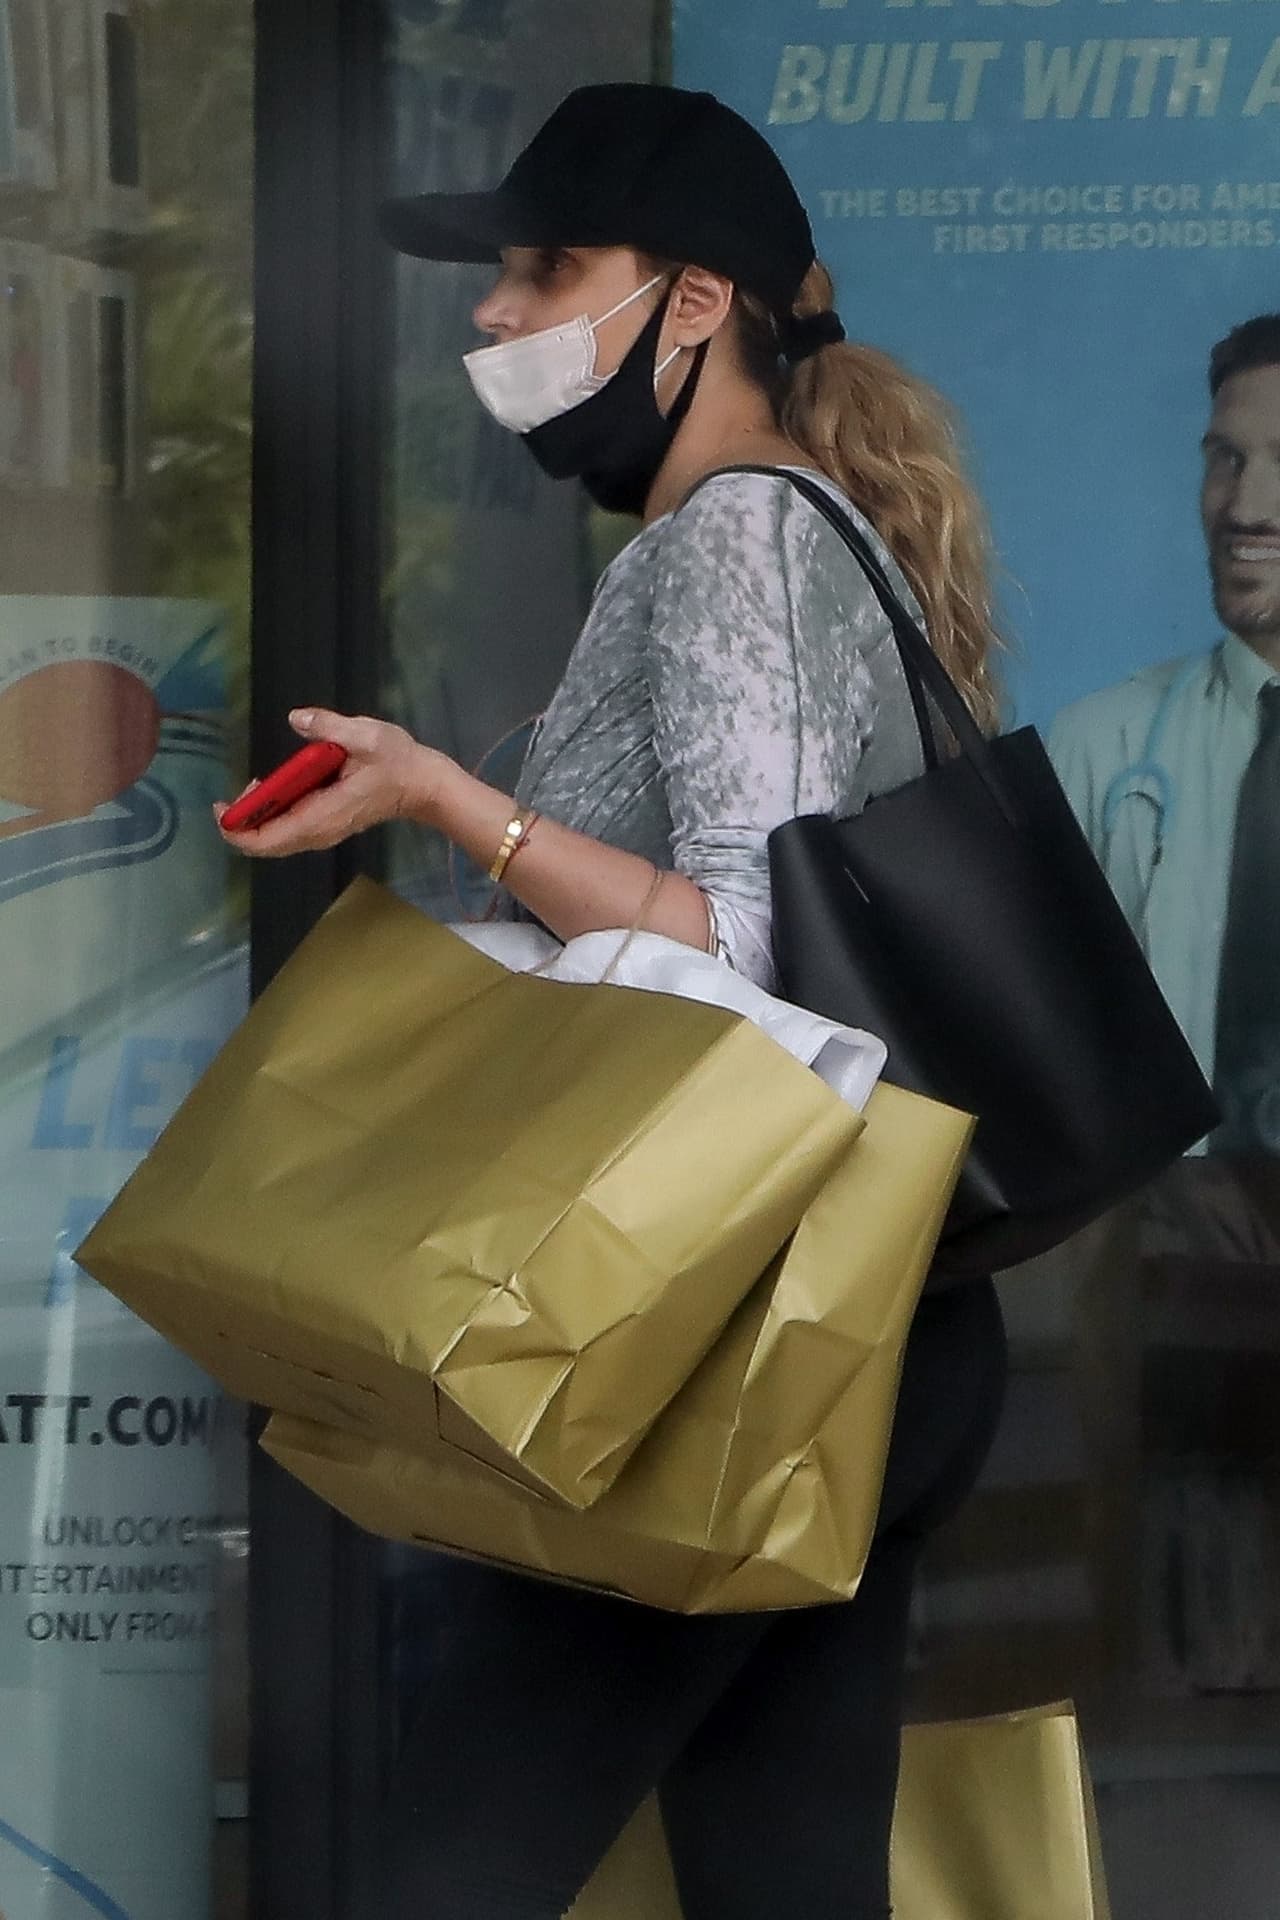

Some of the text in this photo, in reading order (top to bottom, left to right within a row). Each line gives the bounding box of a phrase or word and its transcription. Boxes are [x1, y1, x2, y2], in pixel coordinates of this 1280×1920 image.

[767, 41, 1000, 126] BUILT
[1023, 37, 1231, 120] WITH
[818, 189, 888, 219] THE
[896, 186, 982, 217] BEST
[993, 184, 1122, 216] CHOICE
[1132, 183, 1201, 213] FOR
[933, 224, 1032, 254] FIRST
[0, 1394, 209, 1447] TT.COM
[26, 1610, 119, 1641] ONLY
